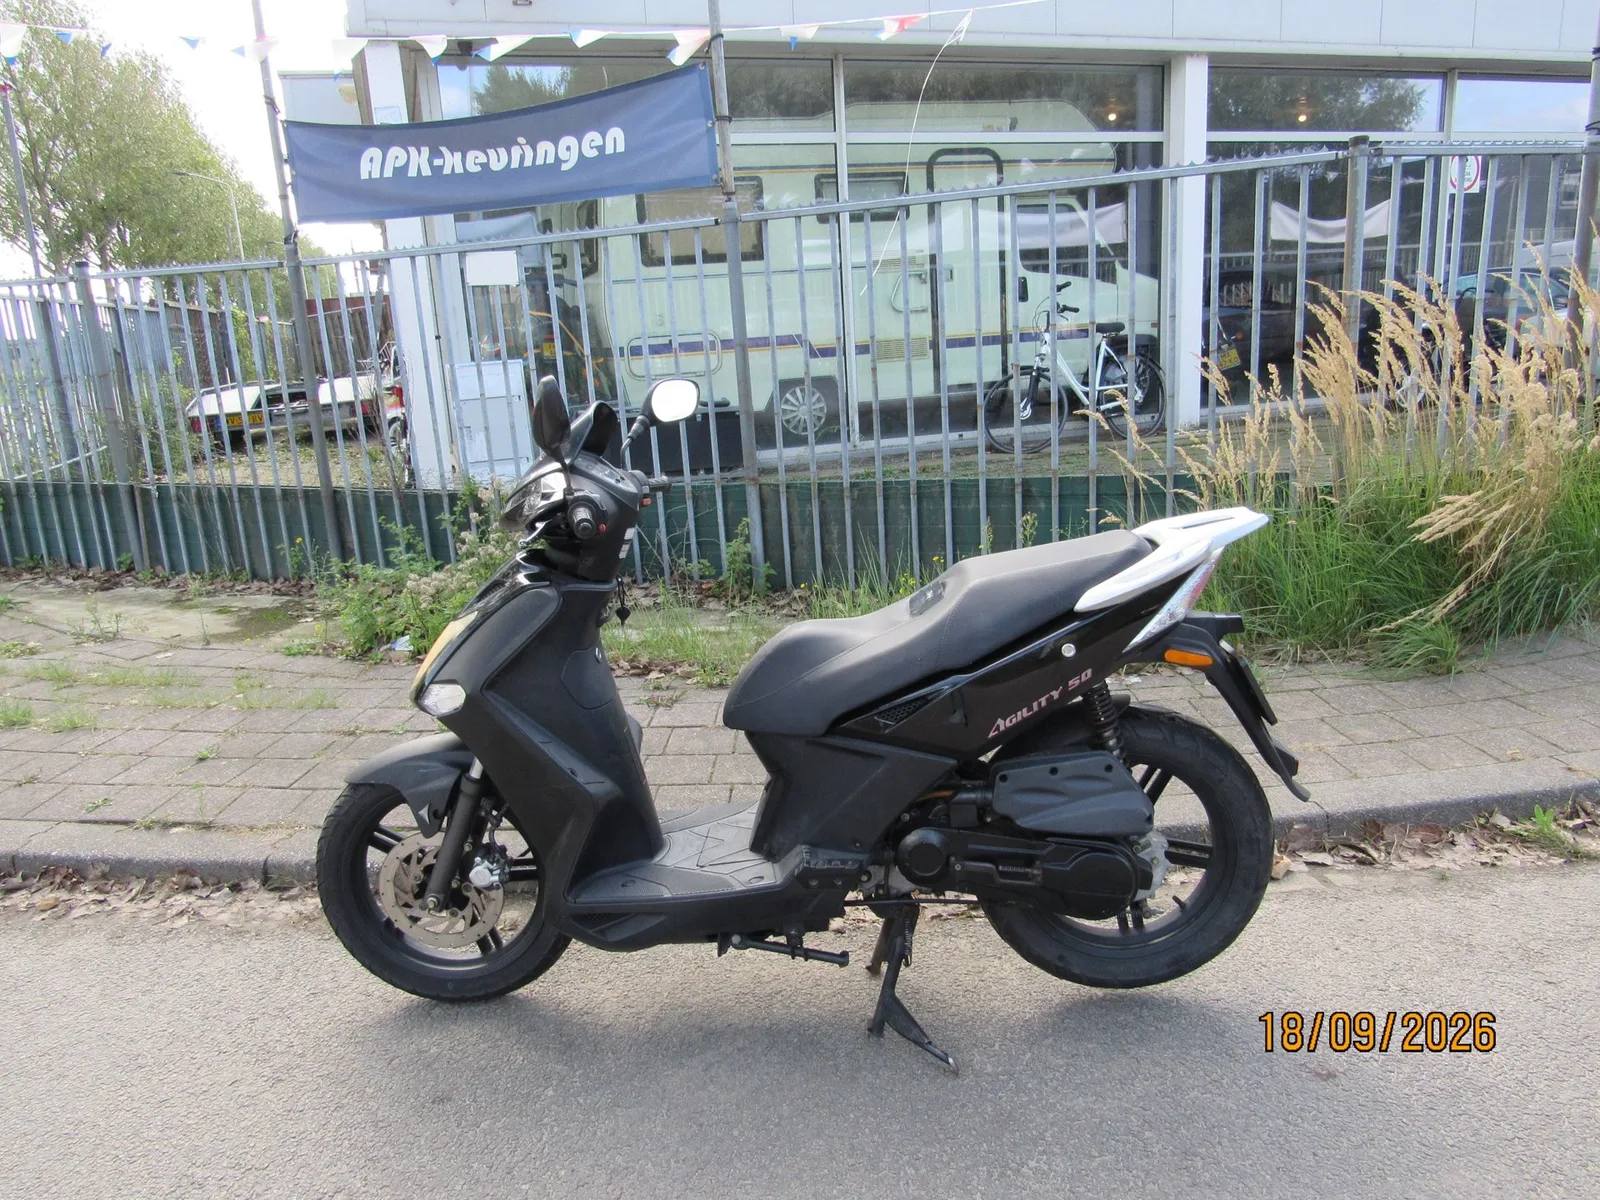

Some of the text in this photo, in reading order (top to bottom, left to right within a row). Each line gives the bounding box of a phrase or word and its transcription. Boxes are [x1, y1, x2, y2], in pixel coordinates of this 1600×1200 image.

[360, 126, 626, 180] APK-keuringen
[987, 667, 1093, 739] AGILITY 50
